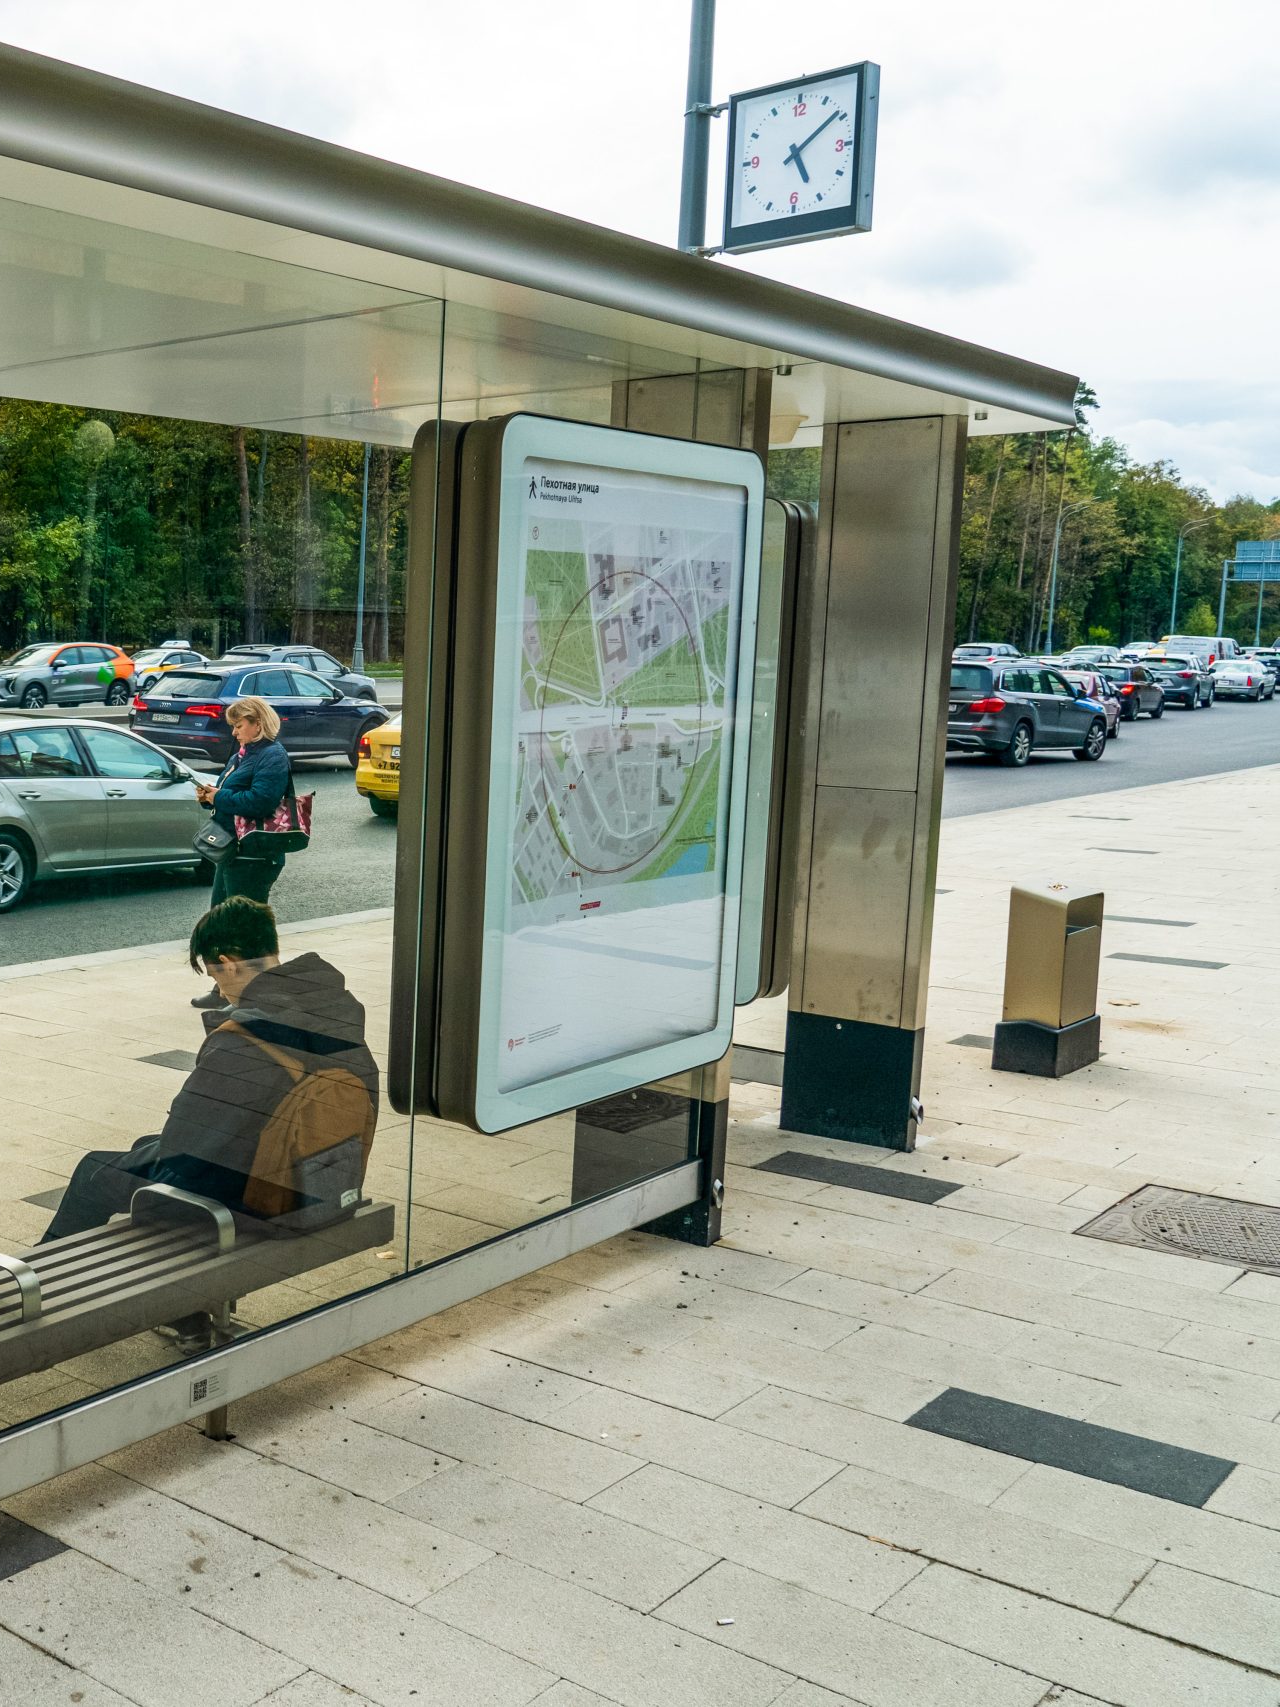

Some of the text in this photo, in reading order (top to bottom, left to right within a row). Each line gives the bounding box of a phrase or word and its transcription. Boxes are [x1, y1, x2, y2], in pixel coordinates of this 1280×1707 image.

[792, 102, 807, 118] 12
[835, 139, 844, 152] 3
[751, 156, 760, 169] 9
[789, 192, 799, 205] 6
[540, 476, 600, 494] Пехотная улица
